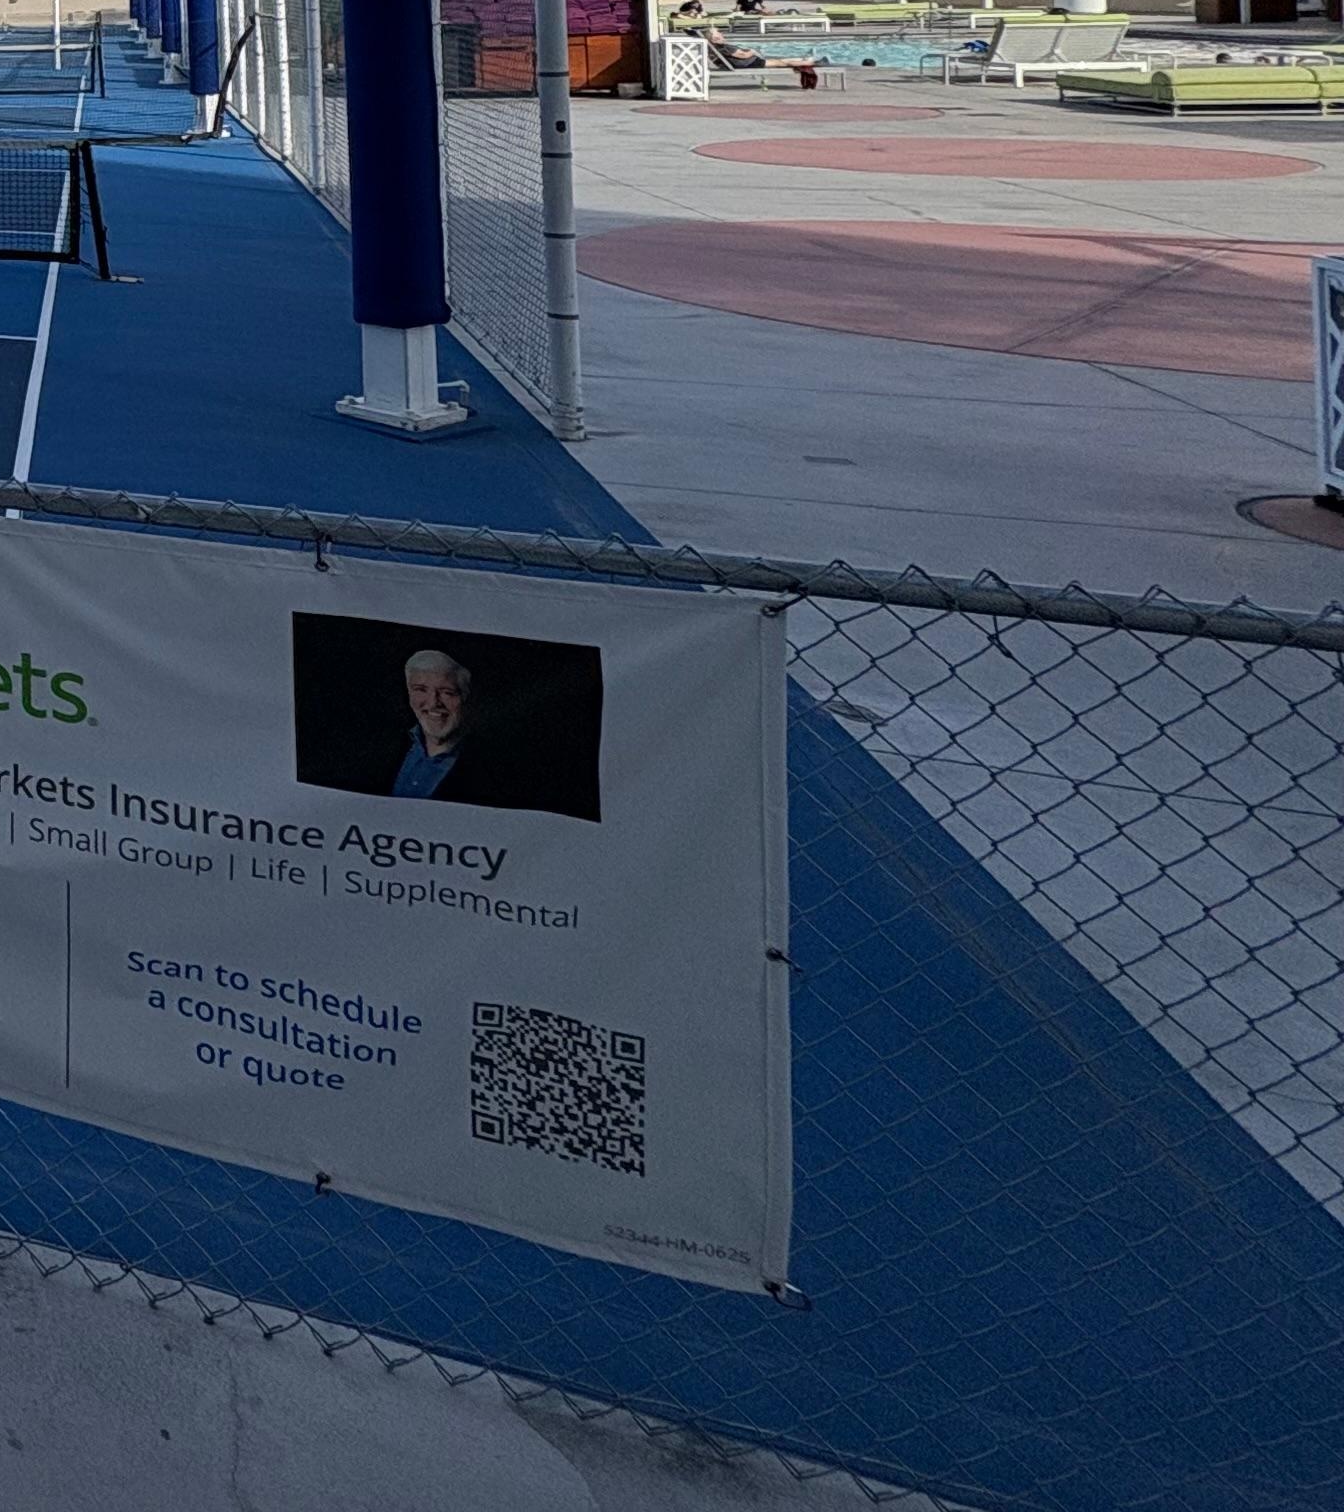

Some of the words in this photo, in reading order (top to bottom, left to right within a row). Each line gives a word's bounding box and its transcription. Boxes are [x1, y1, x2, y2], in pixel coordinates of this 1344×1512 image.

[29, 817, 108, 857] Small
[118, 838, 214, 875] Group
[251, 857, 306, 886] Life
[345, 869, 579, 929] Supplemental
[110, 782, 324, 850] Insurance
[338, 822, 508, 879] Agency
[127, 949, 203, 984] Scan
[215, 962, 250, 992] to
[261, 972, 423, 1035] schedule
[148, 987, 167, 1011] a
[177, 993, 398, 1066] consultation
[196, 1041, 231, 1069] or
[242, 1052, 345, 1093] quote
